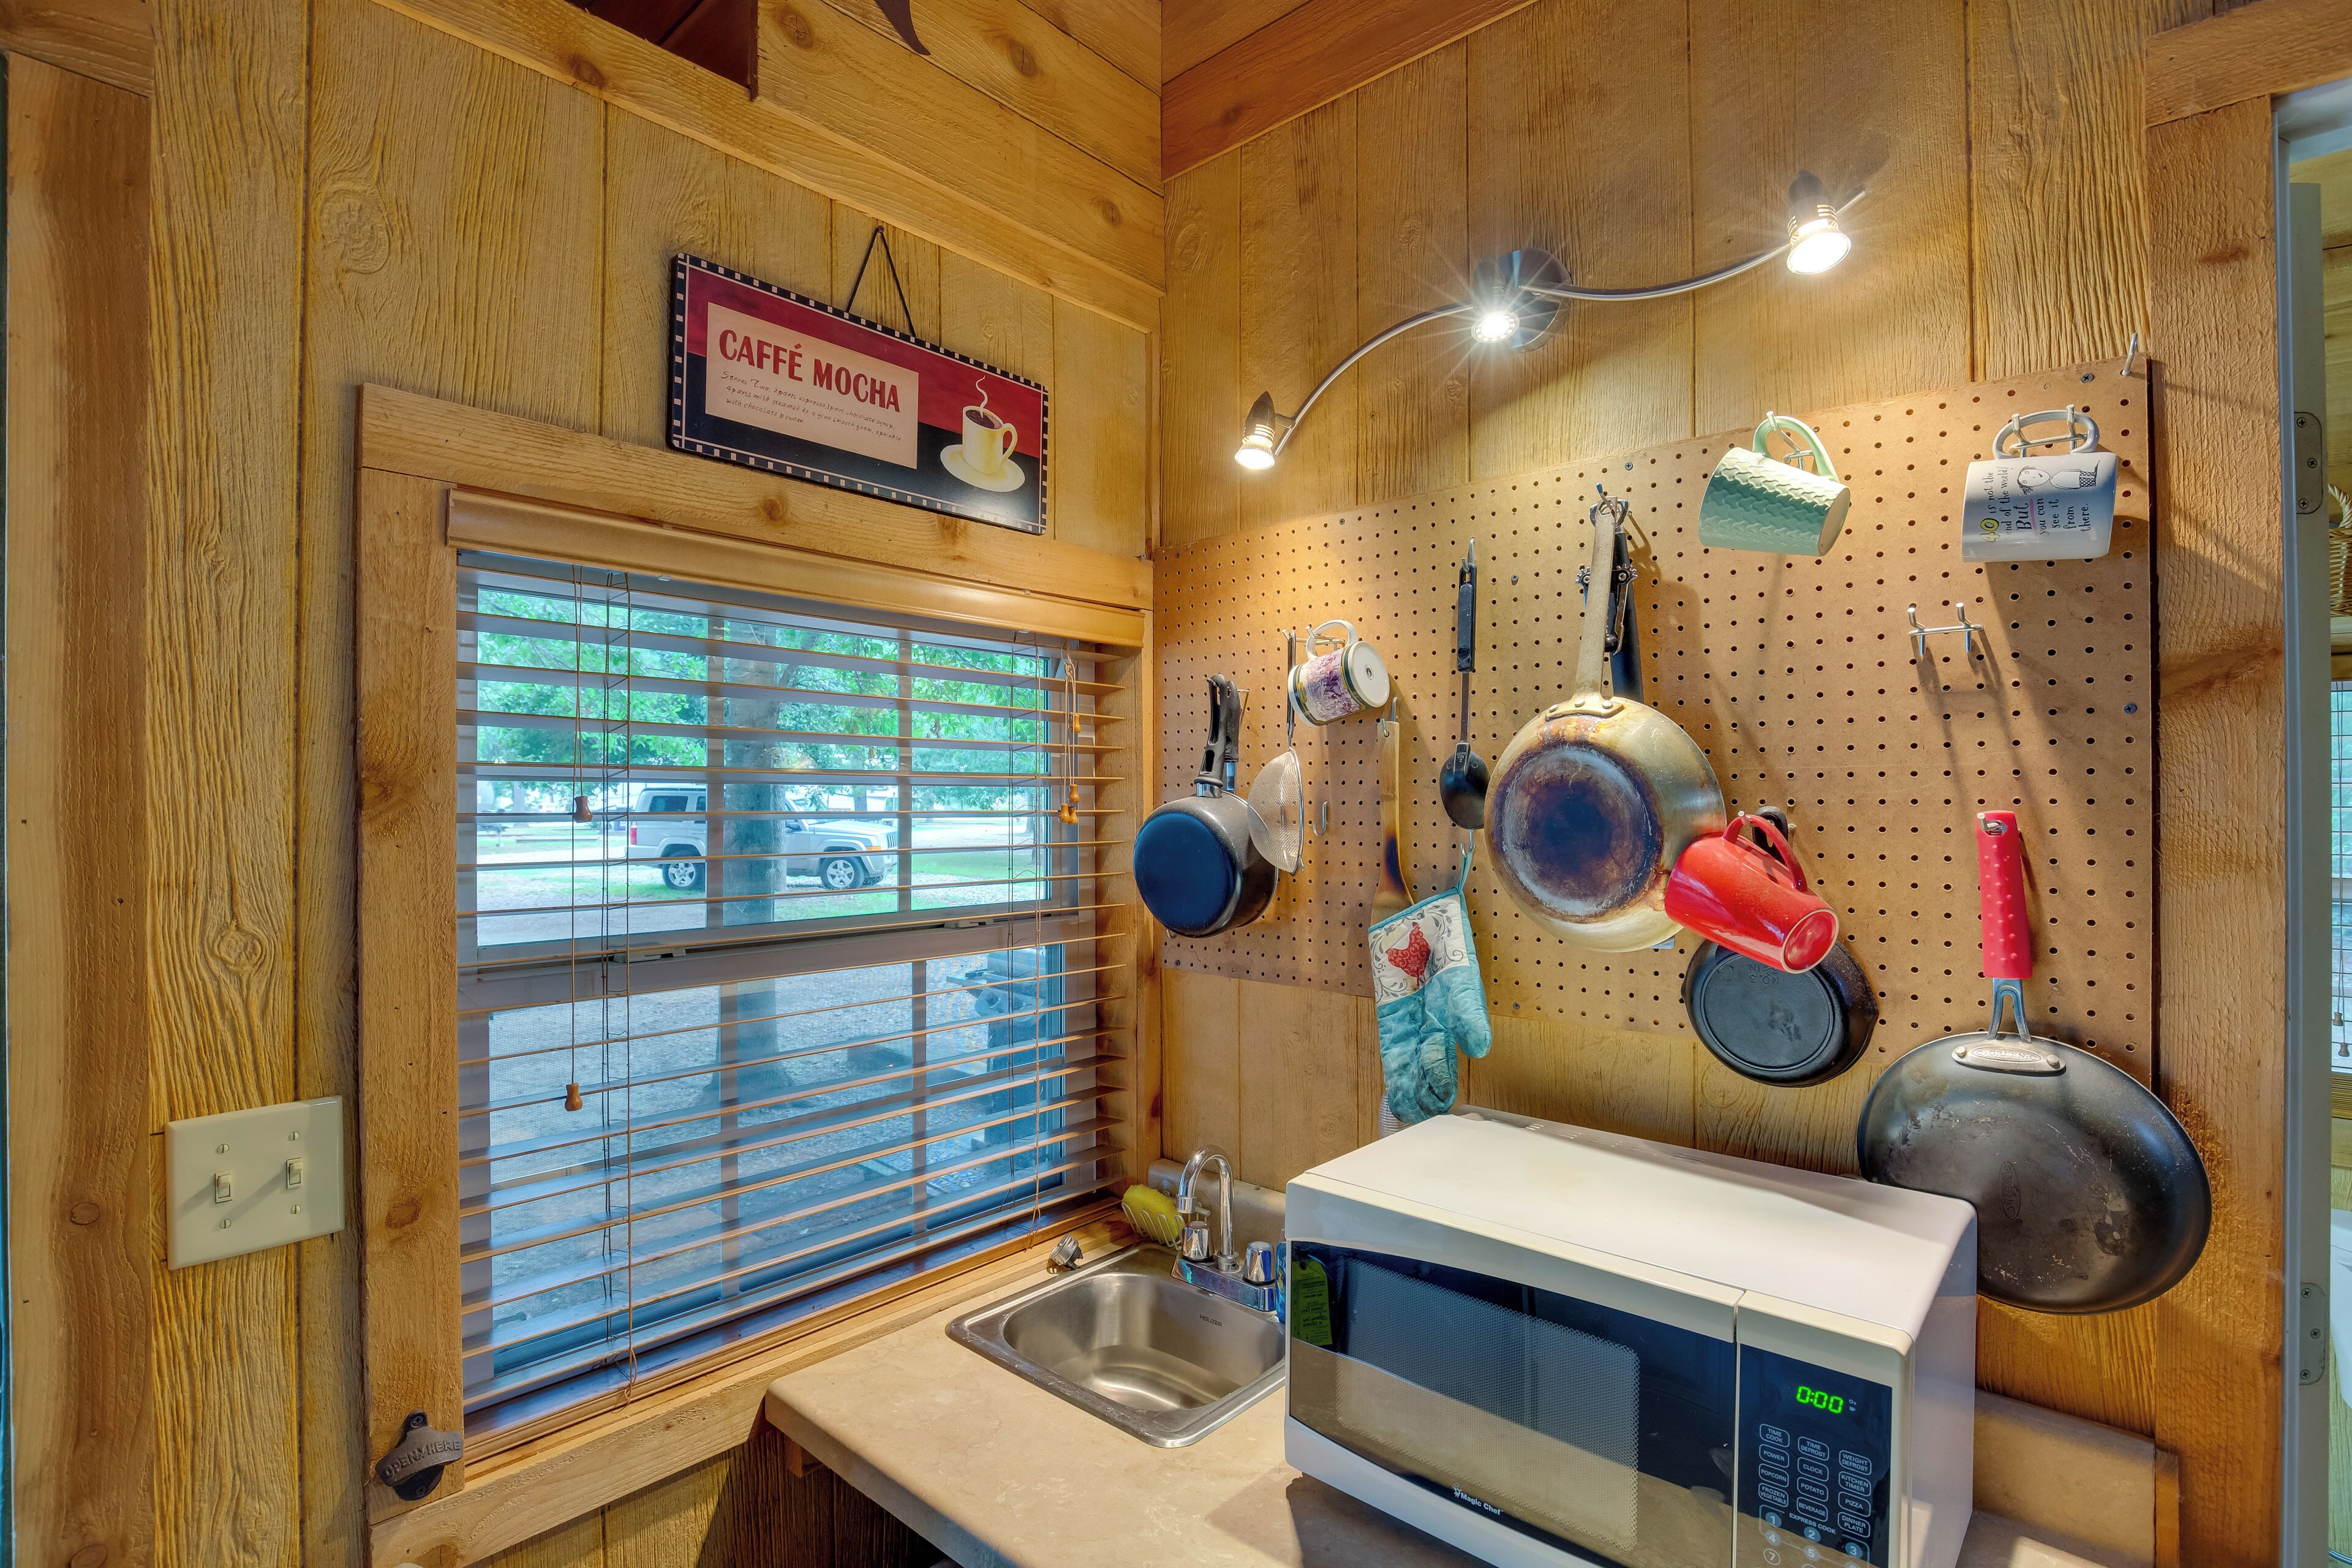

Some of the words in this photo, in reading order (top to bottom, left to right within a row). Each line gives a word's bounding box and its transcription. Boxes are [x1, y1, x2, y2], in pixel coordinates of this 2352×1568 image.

[719, 329, 803, 382] CAFFÉ
[813, 358, 900, 413] MOCHA
[720, 371, 747, 385] Serves
[750, 379, 772, 392] Two:
[744, 402, 777, 417] chocolate
[772, 400, 800, 411] steamed
[832, 417, 854, 427] smooth
[875, 430, 901, 442] sprinkle
[1981, 472, 1994, 484] the
[1985, 486, 1994, 500] not
[1997, 491, 2010, 505] the
[1988, 504, 1997, 514] is
[2037, 497, 2045, 515] can
[2048, 499, 2059, 508] it
[1999, 507, 2011, 516] of
[2013, 502, 2032, 530] But
[2063, 505, 2076, 529] from
[2078, 503, 2091, 532] there.
[2051, 513, 2061, 528] see
[1979, 518, 2000, 543] 40
[2000, 521, 2012, 535] end
[2038, 519, 2049, 536] you
[1749, 974, 1757, 983] 3
[1199, 1314, 1223, 1327] HOUZER
[1796, 1385, 1844, 1414] 0:00
[1766, 1433, 1783, 1444] COOK
[1768, 1428, 1782, 1438] TIME
[1801, 1445, 1826, 1458] DEFROST
[1806, 1441, 1821, 1450] TIME
[385, 1449, 420, 1478] OPEN
[426, 1441, 460, 1455] HERE
[1763, 1450, 1785, 1461] POWER
[1842, 1453, 1868, 1466] WEIGHT
[1803, 1464, 1823, 1475] CLOCK
[1842, 1459, 1868, 1472] DEFROST
[1760, 1469, 1787, 1482] POPCORN
[1841, 1474, 1868, 1488] KITCHEN
[1762, 1486, 1785, 1498] FROZEN
[1801, 1483, 1825, 1495] POTATO
[1845, 1481, 1864, 1493] TIMER
[1460, 1491, 1482, 1506] Magic
[1483, 1502, 1501, 1515] Chef
[1760, 1491, 1787, 1505] VEGETABLE
[1845, 1499, 1863, 1509] PIZZA
[1798, 1502, 1826, 1516] BEVERAGE
[1770, 1515, 1775, 1525] 1
[1789, 1512, 1817, 1526] EXPRESS
[1818, 1523, 1836, 1534] COOK
[1842, 1515, 1866, 1528] DINNER
[1808, 1529, 1815, 1539] 2
[1844, 1522, 1863, 1534] PLATE
[1769, 1534, 1776, 1543] 4
[1769, 1551, 1776, 1561] 7
[1807, 1548, 1814, 1558] 5
[1850, 1546, 1857, 1556] 3
